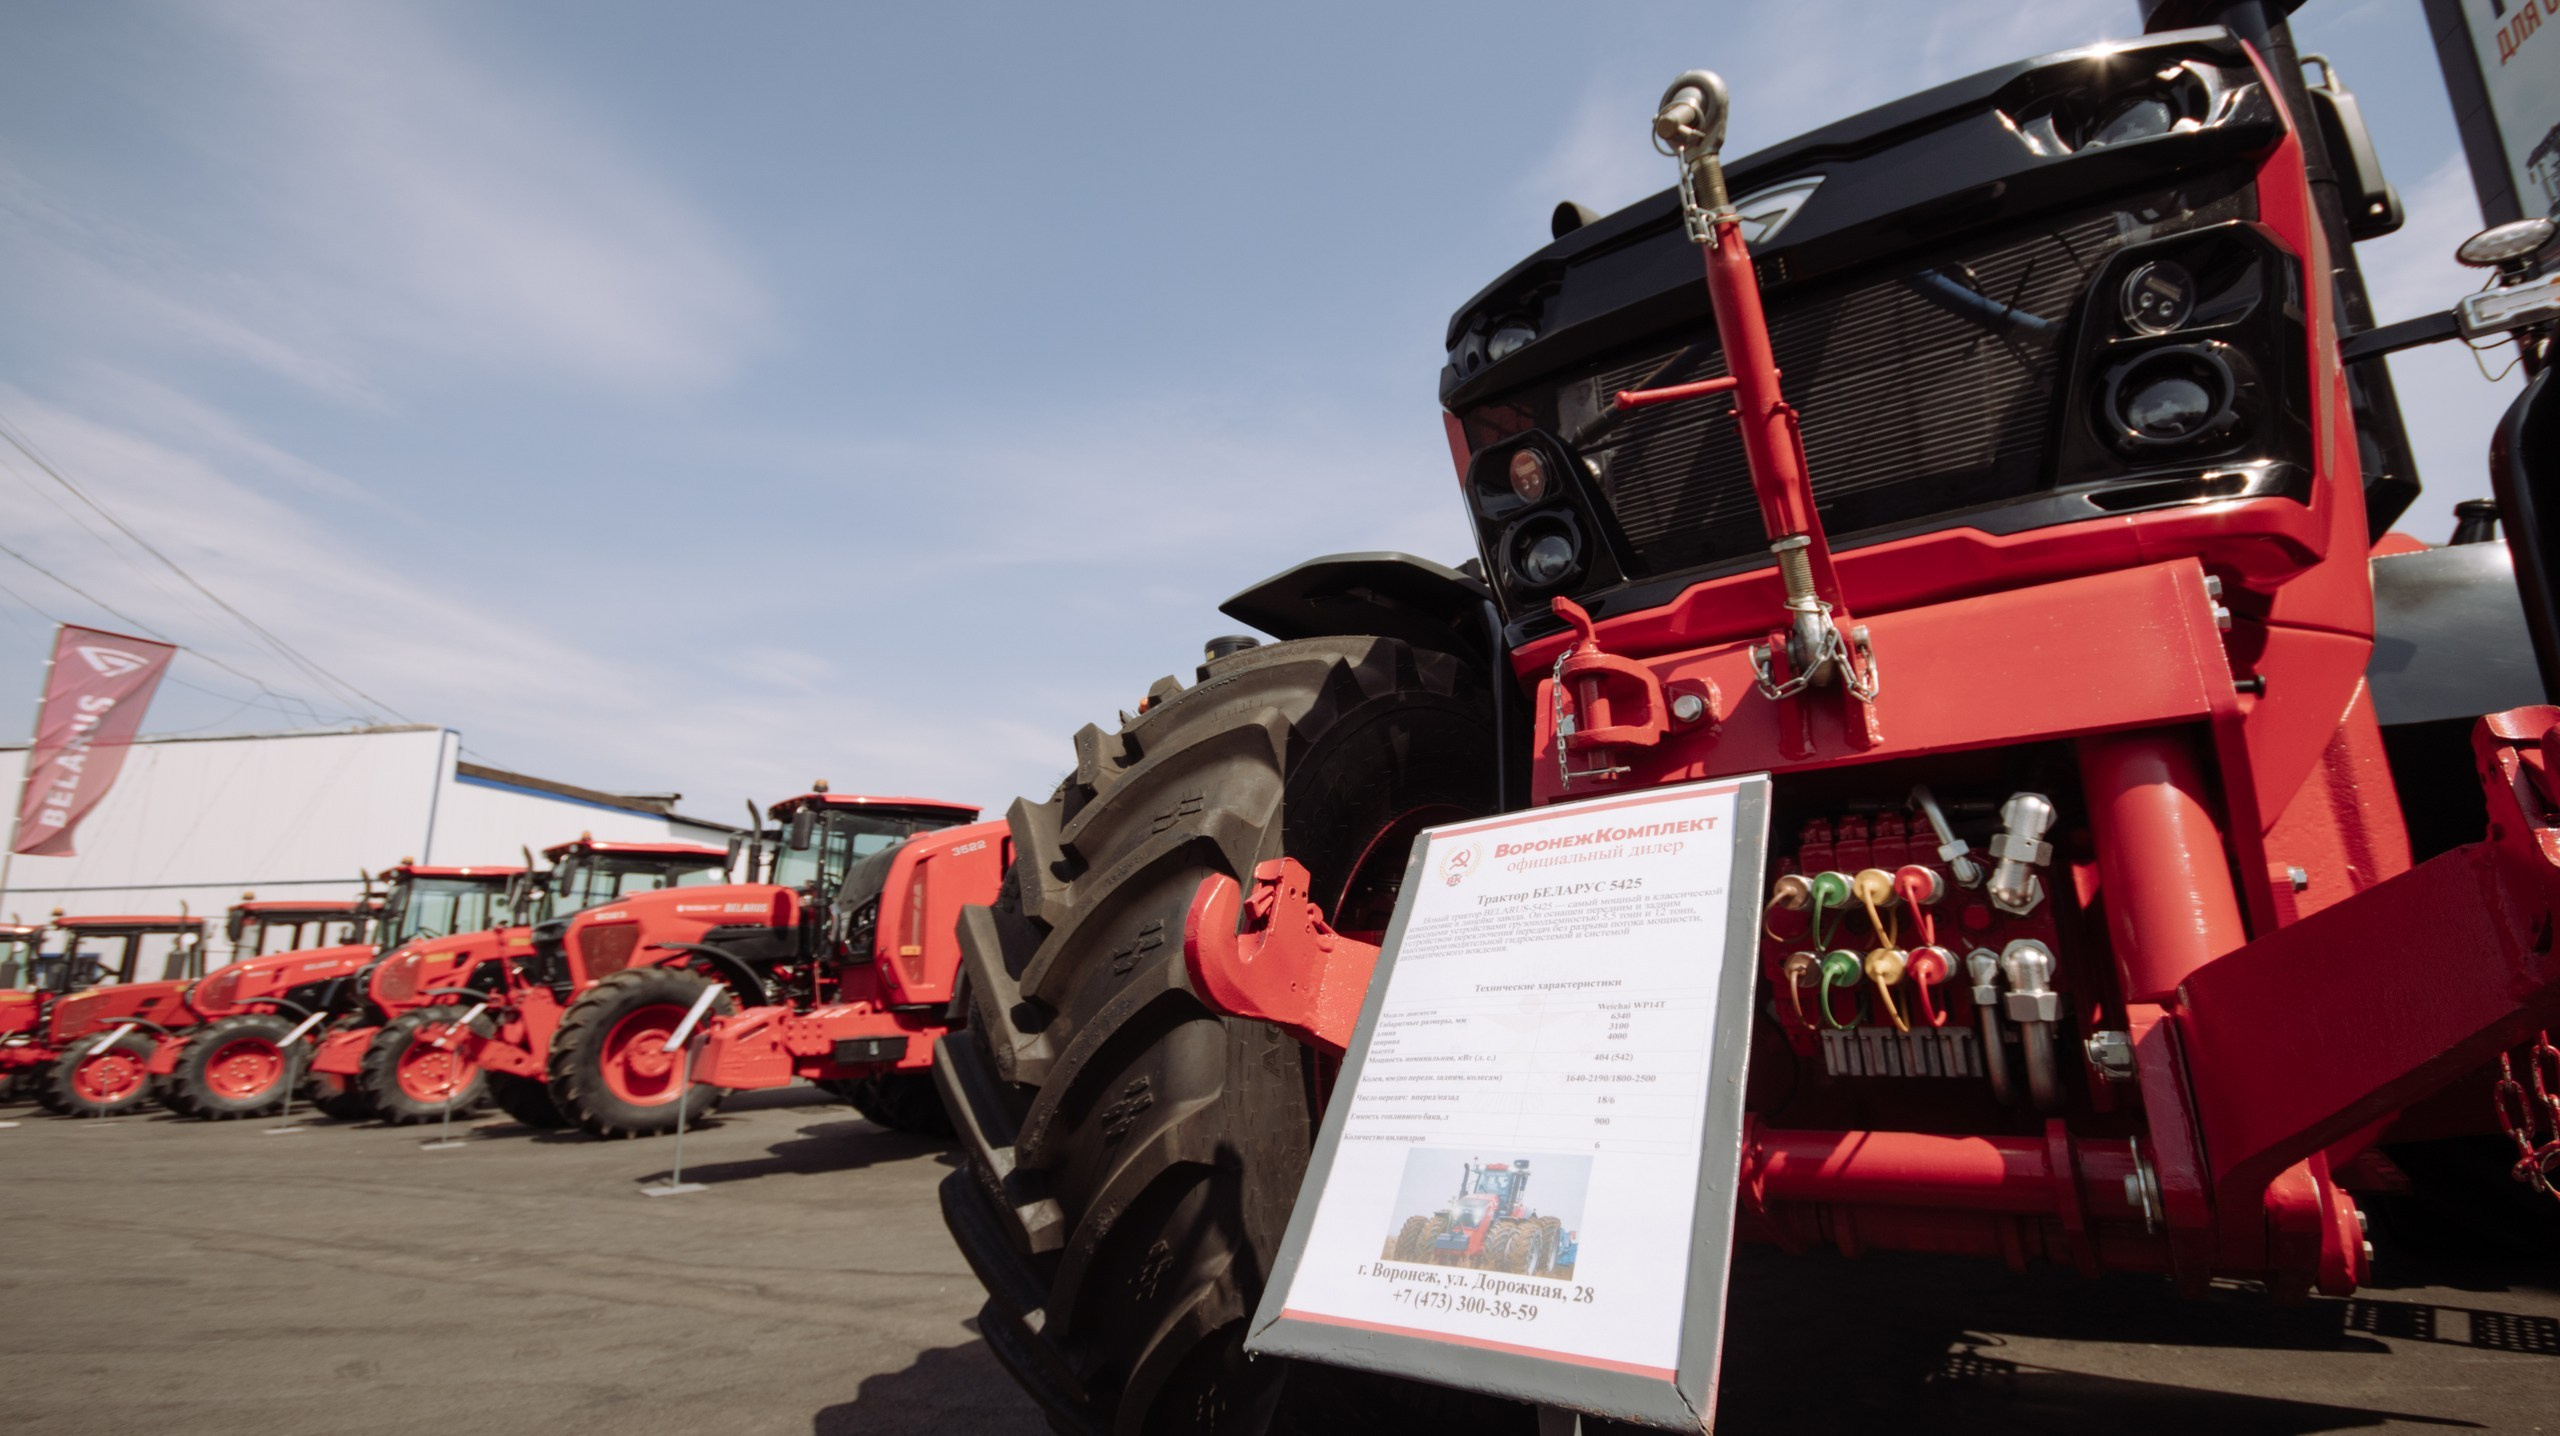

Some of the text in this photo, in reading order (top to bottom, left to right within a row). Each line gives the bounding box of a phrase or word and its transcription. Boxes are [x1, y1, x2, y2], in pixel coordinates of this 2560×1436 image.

[2496, 0, 2542, 66] ДЛЯ
[952, 840, 986, 856] 3522
[1507, 841, 1684, 873] официальный дилер
[1477, 877, 1643, 906] Трактор БЕЛАРУС 5425
[1423, 914, 1450, 925] Новый
[1451, 911, 1482, 922] трактор
[1484, 902, 1553, 917] BELARUS-5425
[1567, 897, 1598, 908] самый
[1600, 894, 1642, 906] мощный
[1653, 887, 1723, 901] классической
[1529, 911, 1542, 919] Он
[1586, 904, 1633, 915] передним
[1644, 900, 1681, 910] задним
[1619, 910, 1642, 919] тонн
[1655, 908, 1666, 916] 12
[1505, 930, 1573, 944] гидросистемой
[1584, 927, 1630, 938] системой
[1515, 927, 1551, 937] передач
[1553, 924, 1567, 932] без
[1569, 922, 1608, 934] разрыва
[1611, 919, 1644, 928] потока
[1475, 979, 1622, 993] Технические характеристики
[1608, 1022, 1630, 1030] 3100
[1607, 1032, 1628, 1040] 4000
[1594, 1053, 1634, 1062] 404 (542)
[1566, 1074, 1656, 1082] 1640-2190/1800-2500
[1597, 1096, 1615, 1104] 18/6
[1594, 1117, 1610, 1126] 900
[1358, 1262, 1595, 1304] г. Воронеж, ул. Дорожная, 28
[1392, 1288, 1538, 1321] +7 (473) 300-38-59
